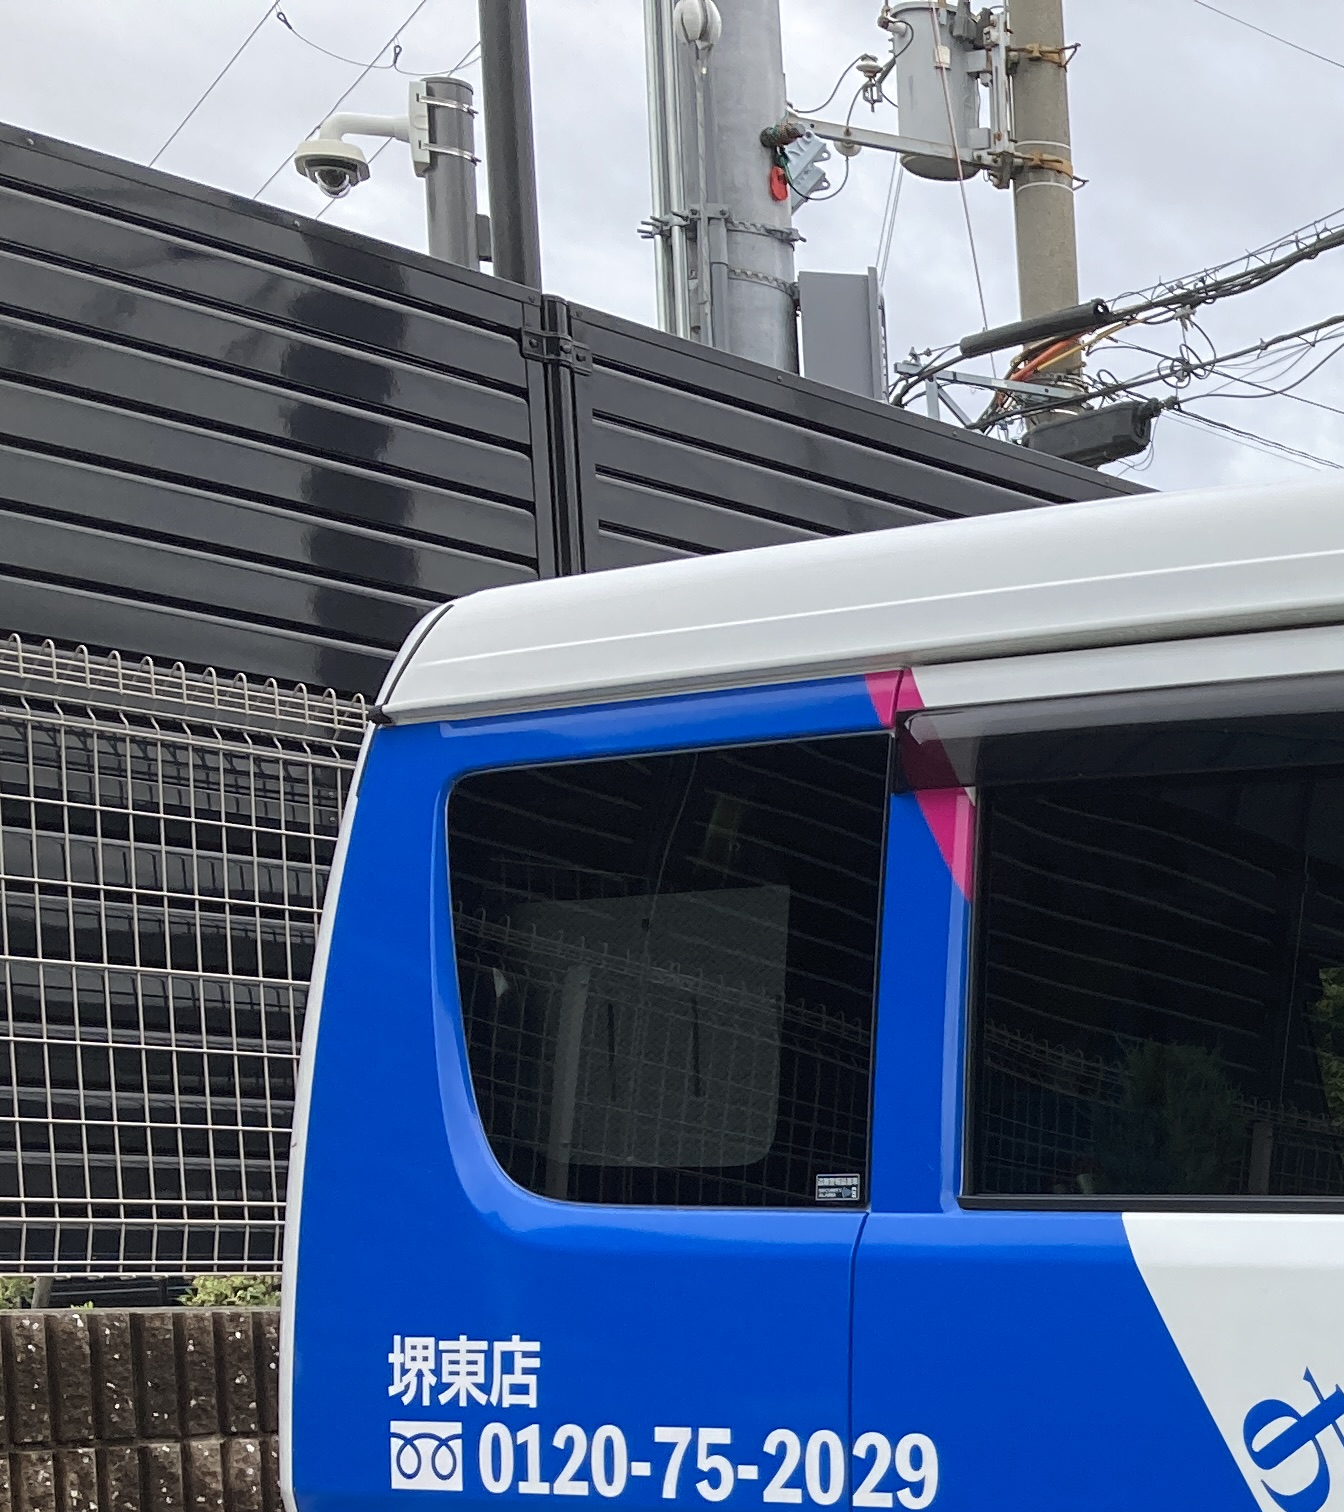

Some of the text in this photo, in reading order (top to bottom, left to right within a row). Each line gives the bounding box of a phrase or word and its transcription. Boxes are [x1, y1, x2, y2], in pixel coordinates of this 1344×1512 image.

[388, 1334, 541, 1409] 堺東店
[478, 1421, 939, 1510] 0120-75-2029
